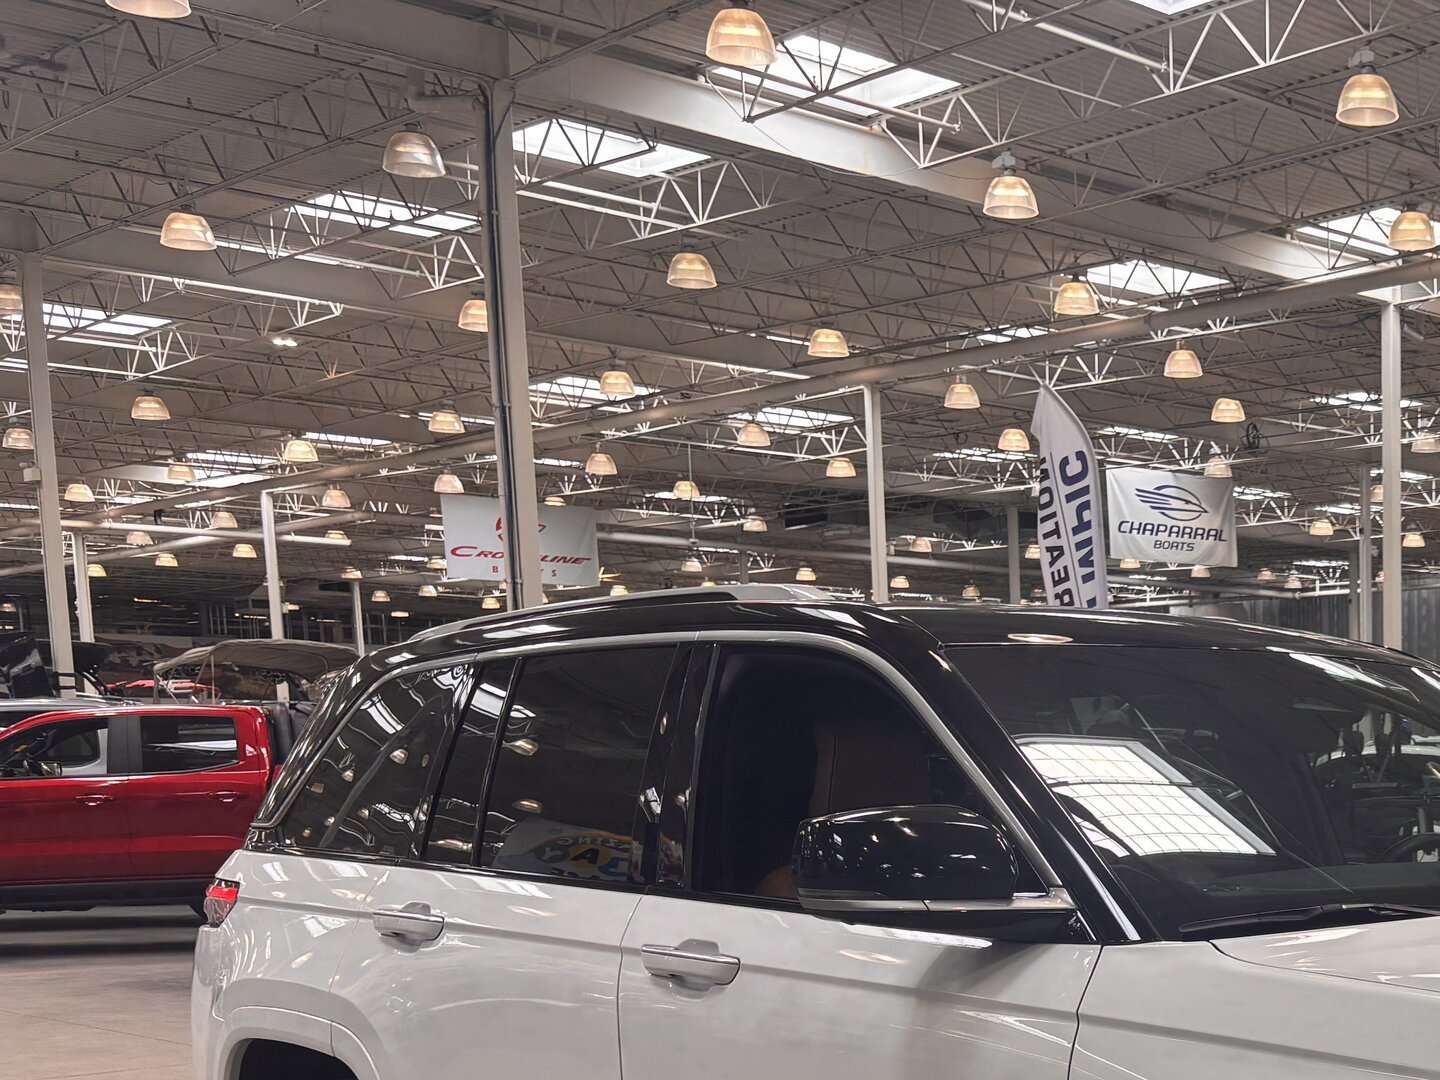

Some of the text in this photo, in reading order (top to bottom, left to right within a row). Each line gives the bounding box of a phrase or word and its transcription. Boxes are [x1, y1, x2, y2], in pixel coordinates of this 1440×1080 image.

[1118, 520, 1228, 542] CHAPARRAL
[450, 545, 592, 565] CROLINE
[1153, 539, 1195, 552] BOATS
